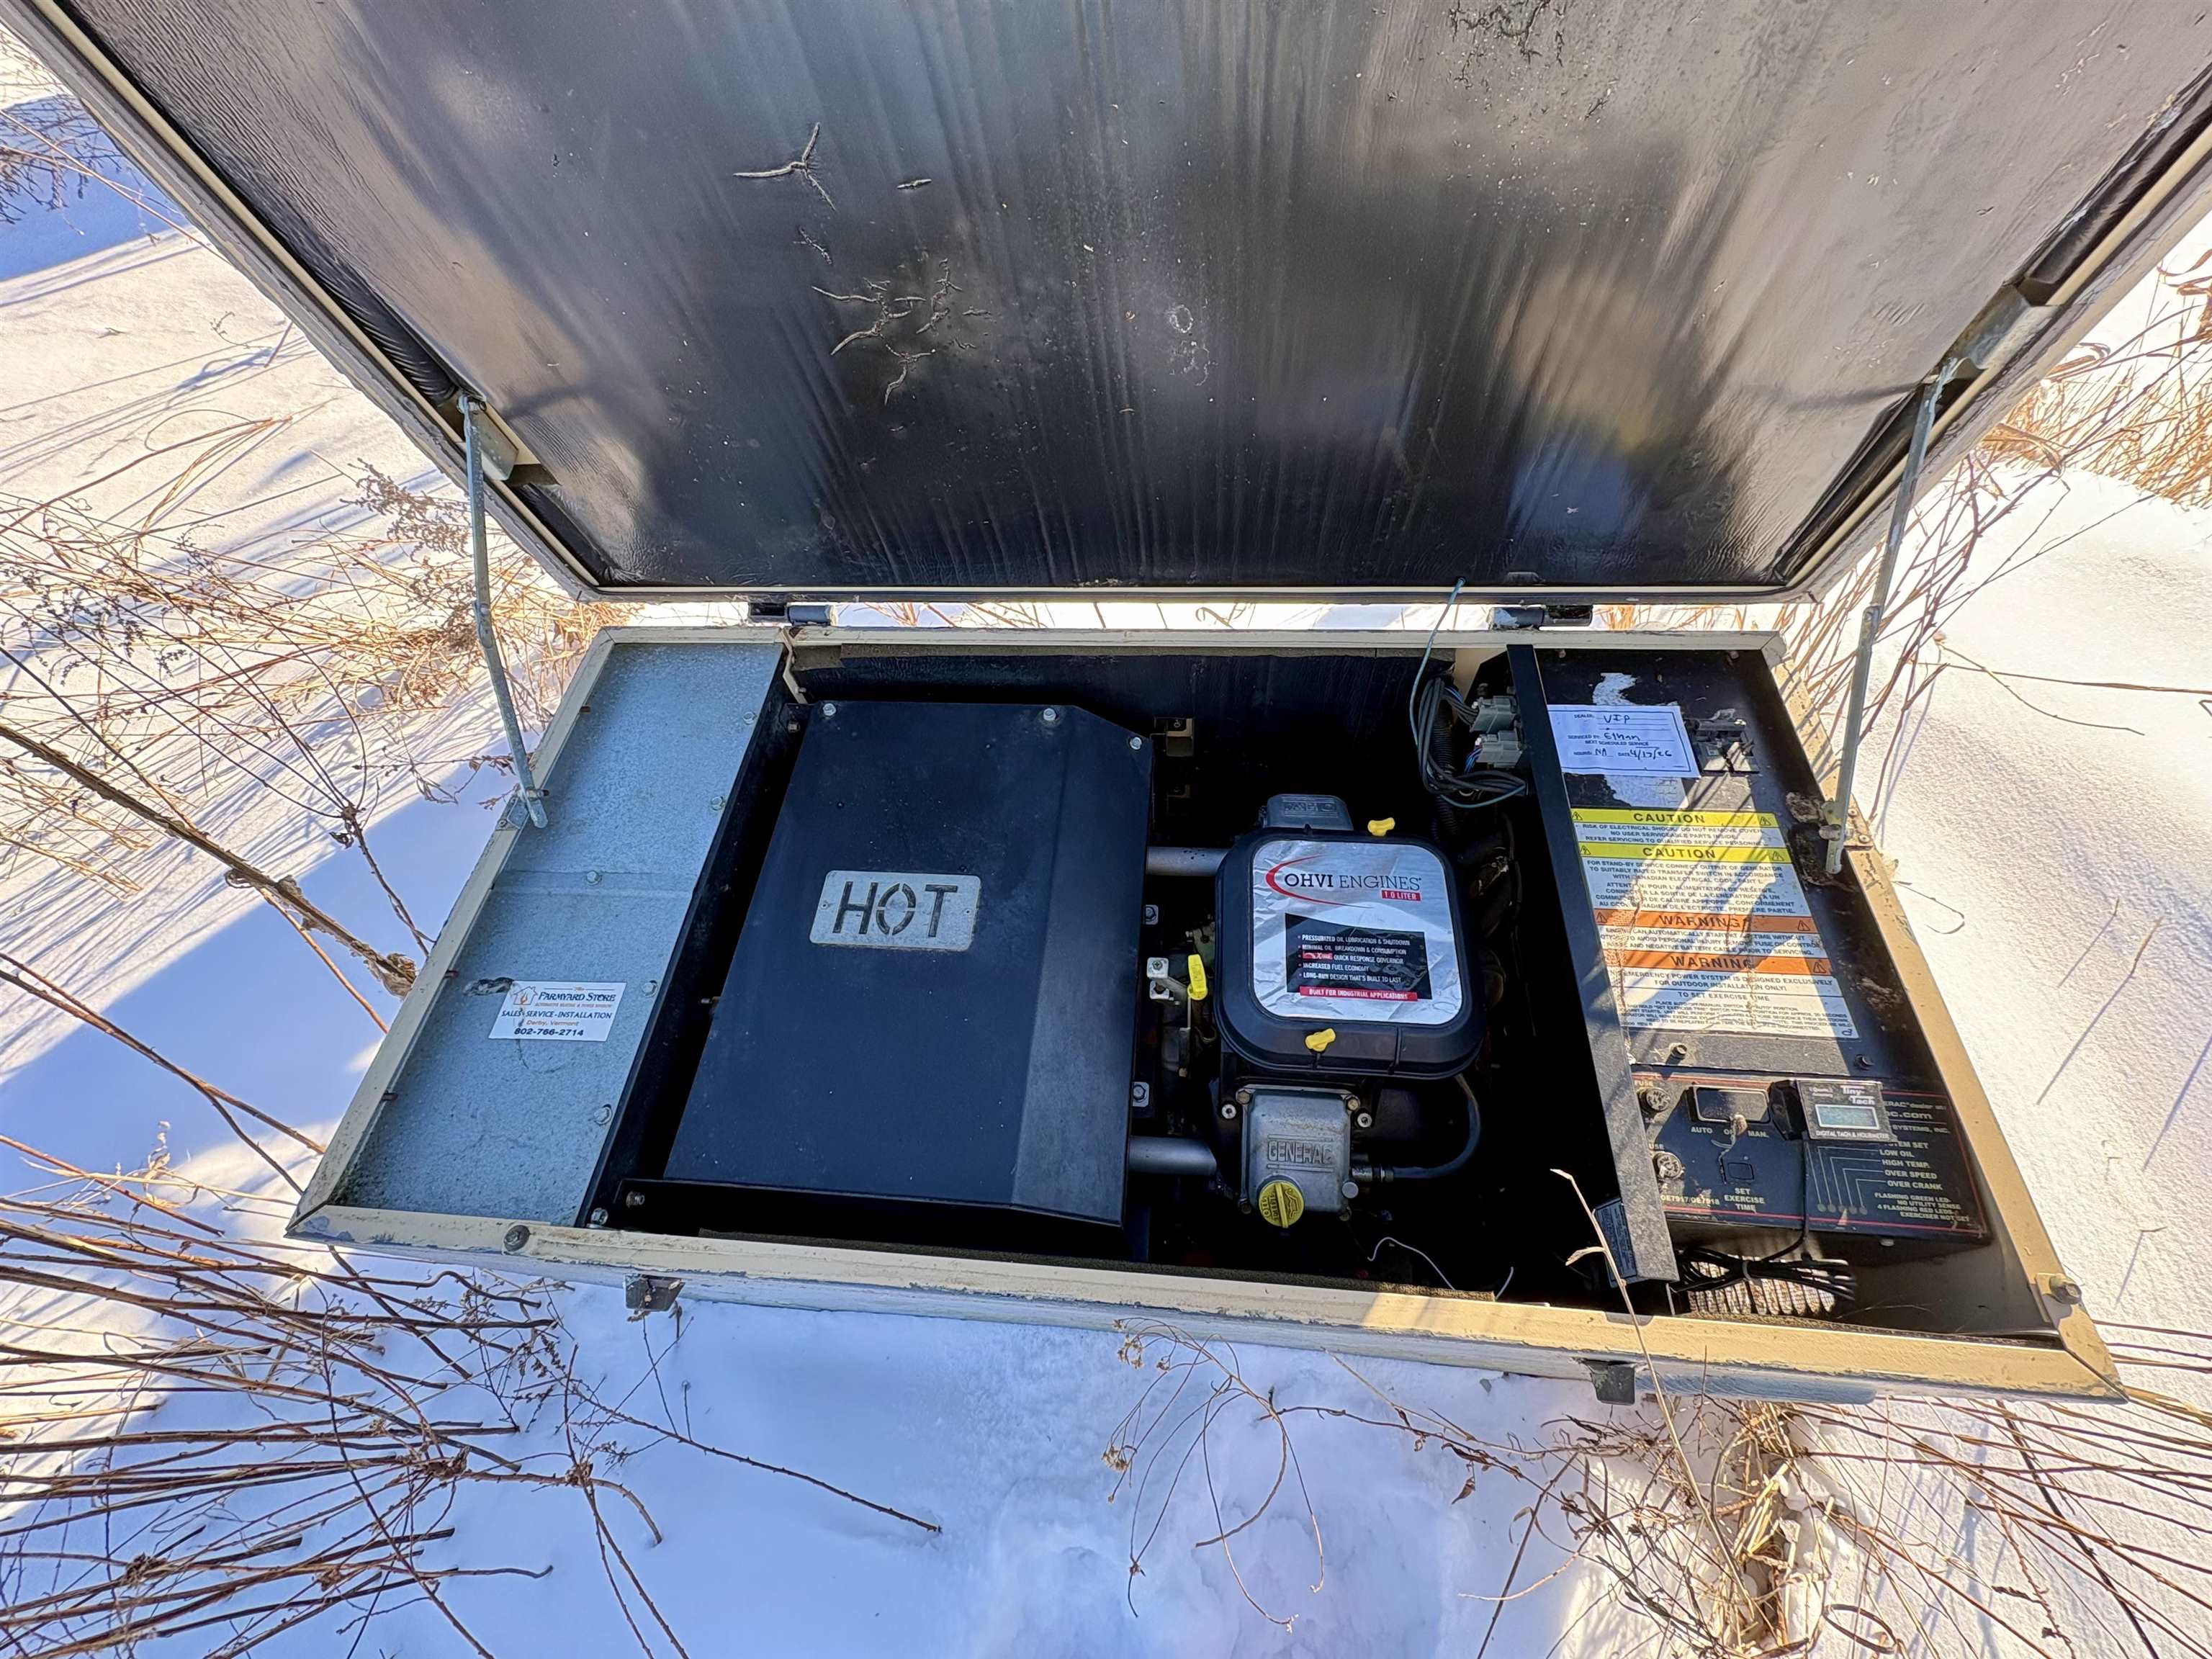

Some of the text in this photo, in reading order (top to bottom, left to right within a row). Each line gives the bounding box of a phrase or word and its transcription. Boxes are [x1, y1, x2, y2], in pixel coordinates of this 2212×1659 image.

[1604, 714, 1629, 724] VIP
[1634, 813, 1705, 823] CAUTION
[1642, 848, 1715, 858] CAUTION
[1284, 873, 1334, 887] OHVI
[832, 881, 958, 937] HOT
[514, 1028, 584, 1036] 802-766-2714
[1268, 1141, 1332, 1164] GENERAC
[1910, 1171, 1938, 1179] SPEED
[1912, 1182, 1943, 1190] CRANK
[1724, 1195, 1766, 1204] EXERCISE
[1883, 1204, 1917, 1213] FLASHING
